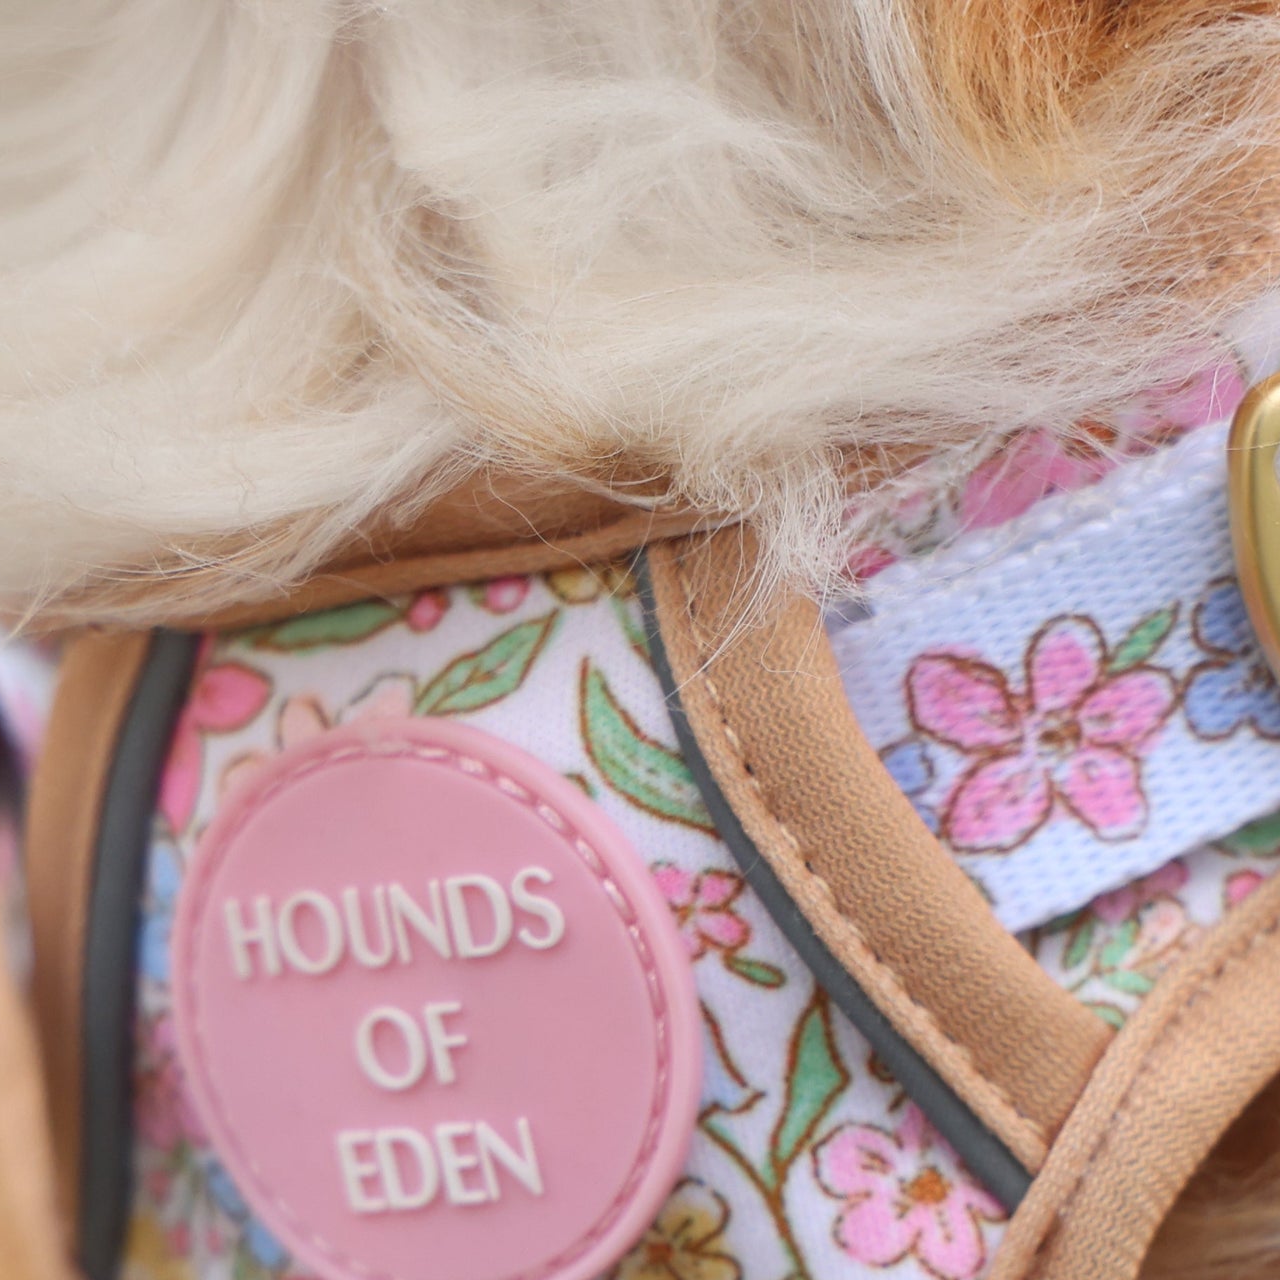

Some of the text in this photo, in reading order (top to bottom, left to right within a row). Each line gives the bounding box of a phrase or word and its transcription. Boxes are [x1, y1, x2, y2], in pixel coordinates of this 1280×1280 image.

[223, 866, 566, 980] HOUNDS
[355, 1001, 469, 1091] OF
[336, 1116, 544, 1213] EDEN
